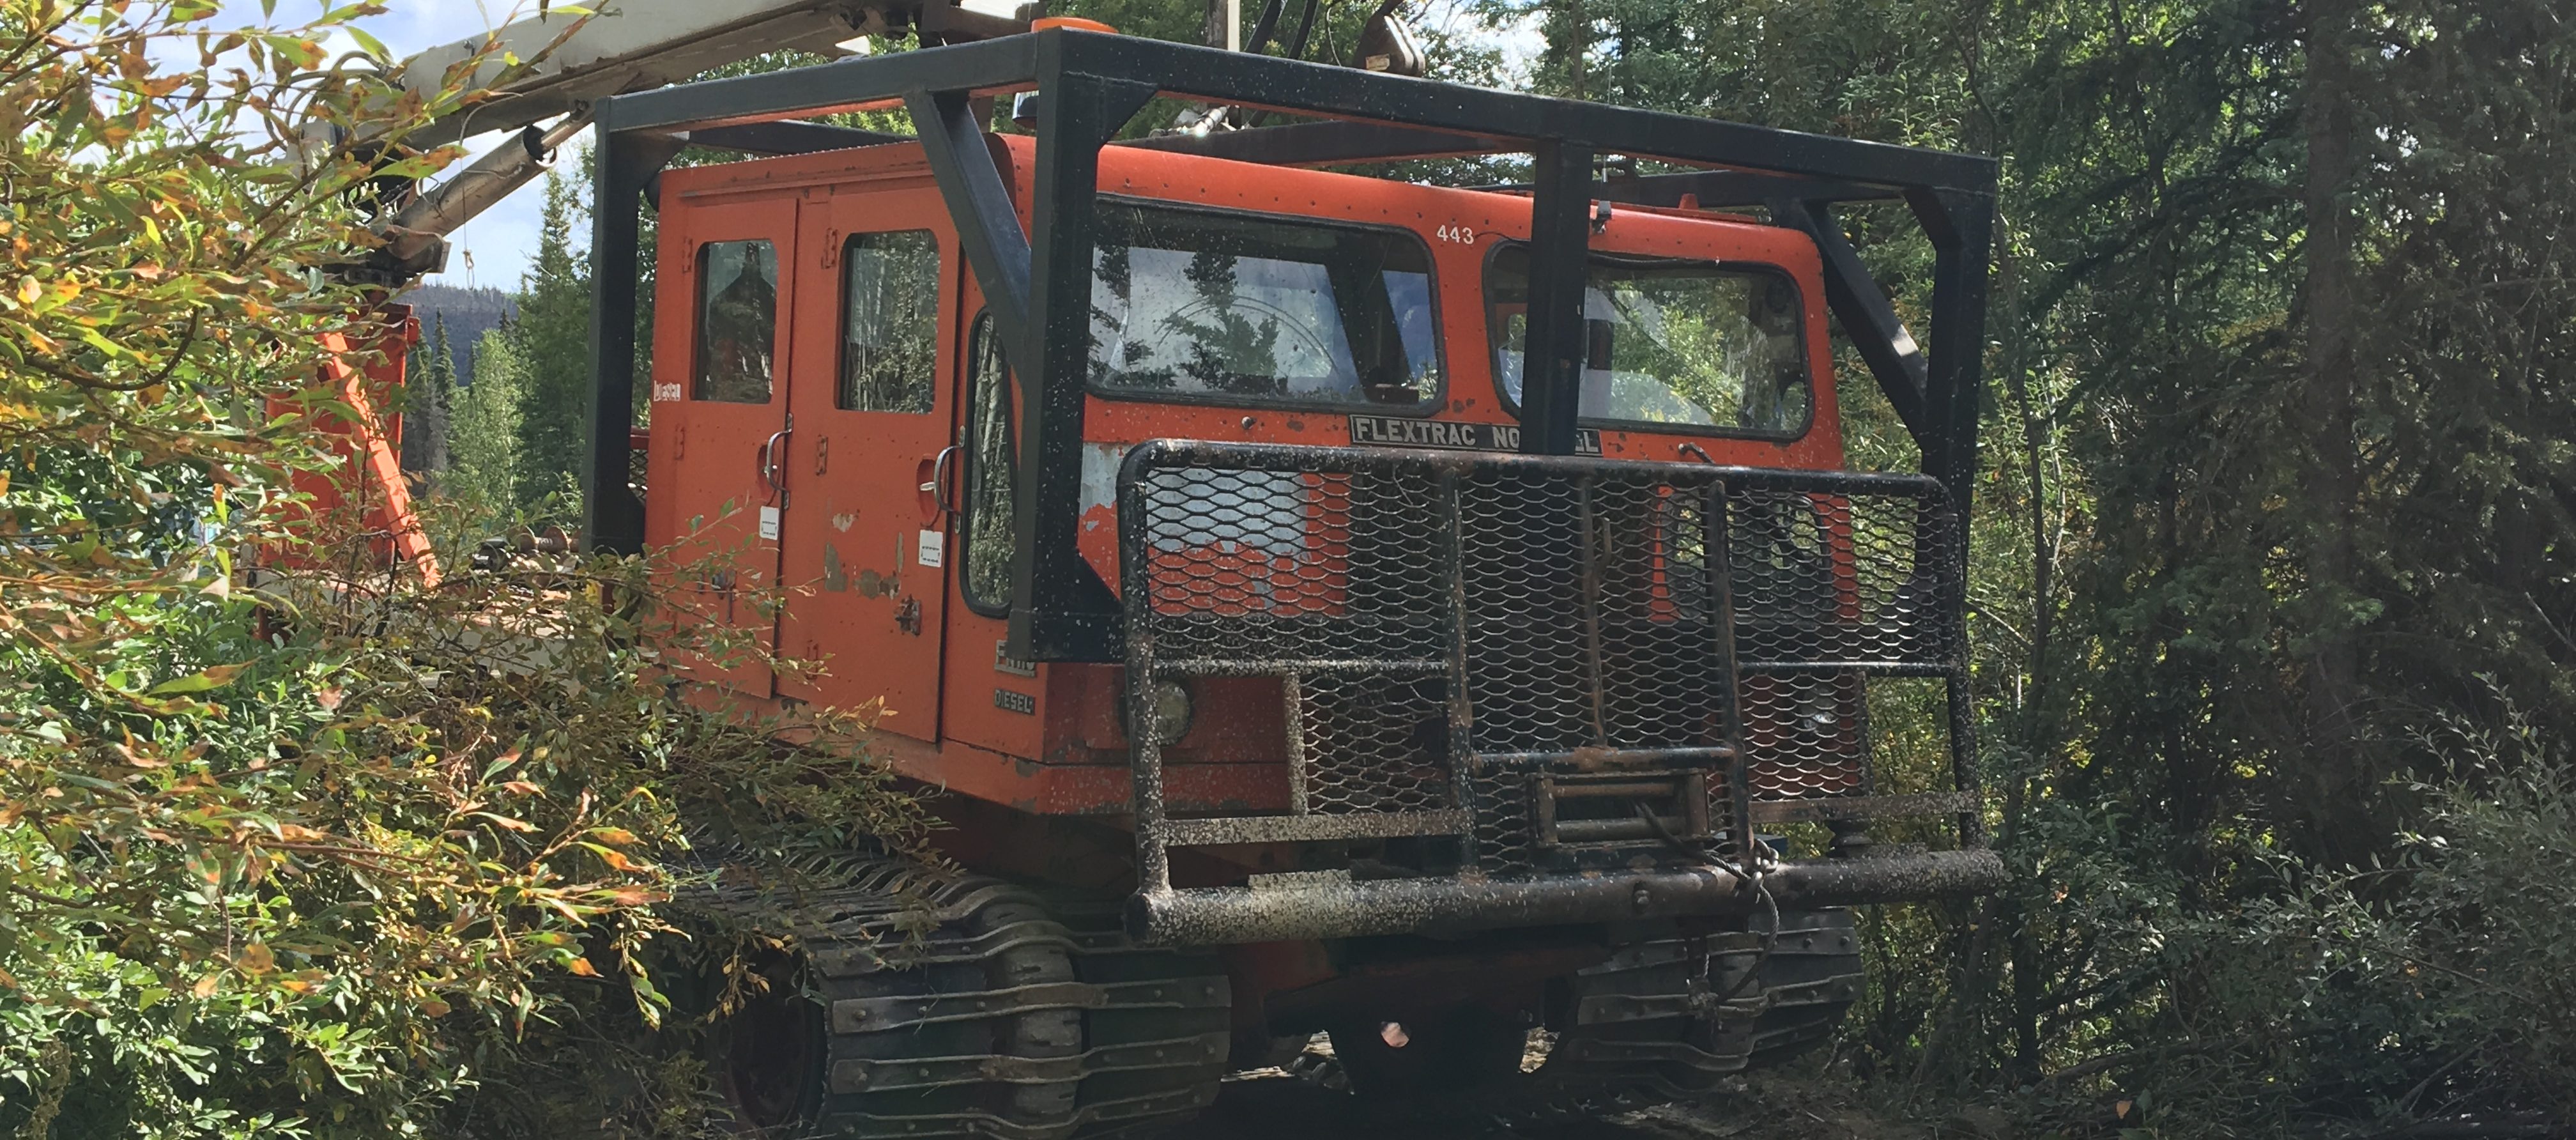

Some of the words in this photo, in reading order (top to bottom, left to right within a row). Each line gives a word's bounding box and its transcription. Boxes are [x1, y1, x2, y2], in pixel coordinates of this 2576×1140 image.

[1437, 224, 1474, 244] 443
[1355, 417, 1476, 446] FLEXTRAC
[994, 689, 1032, 714] DIESEL
